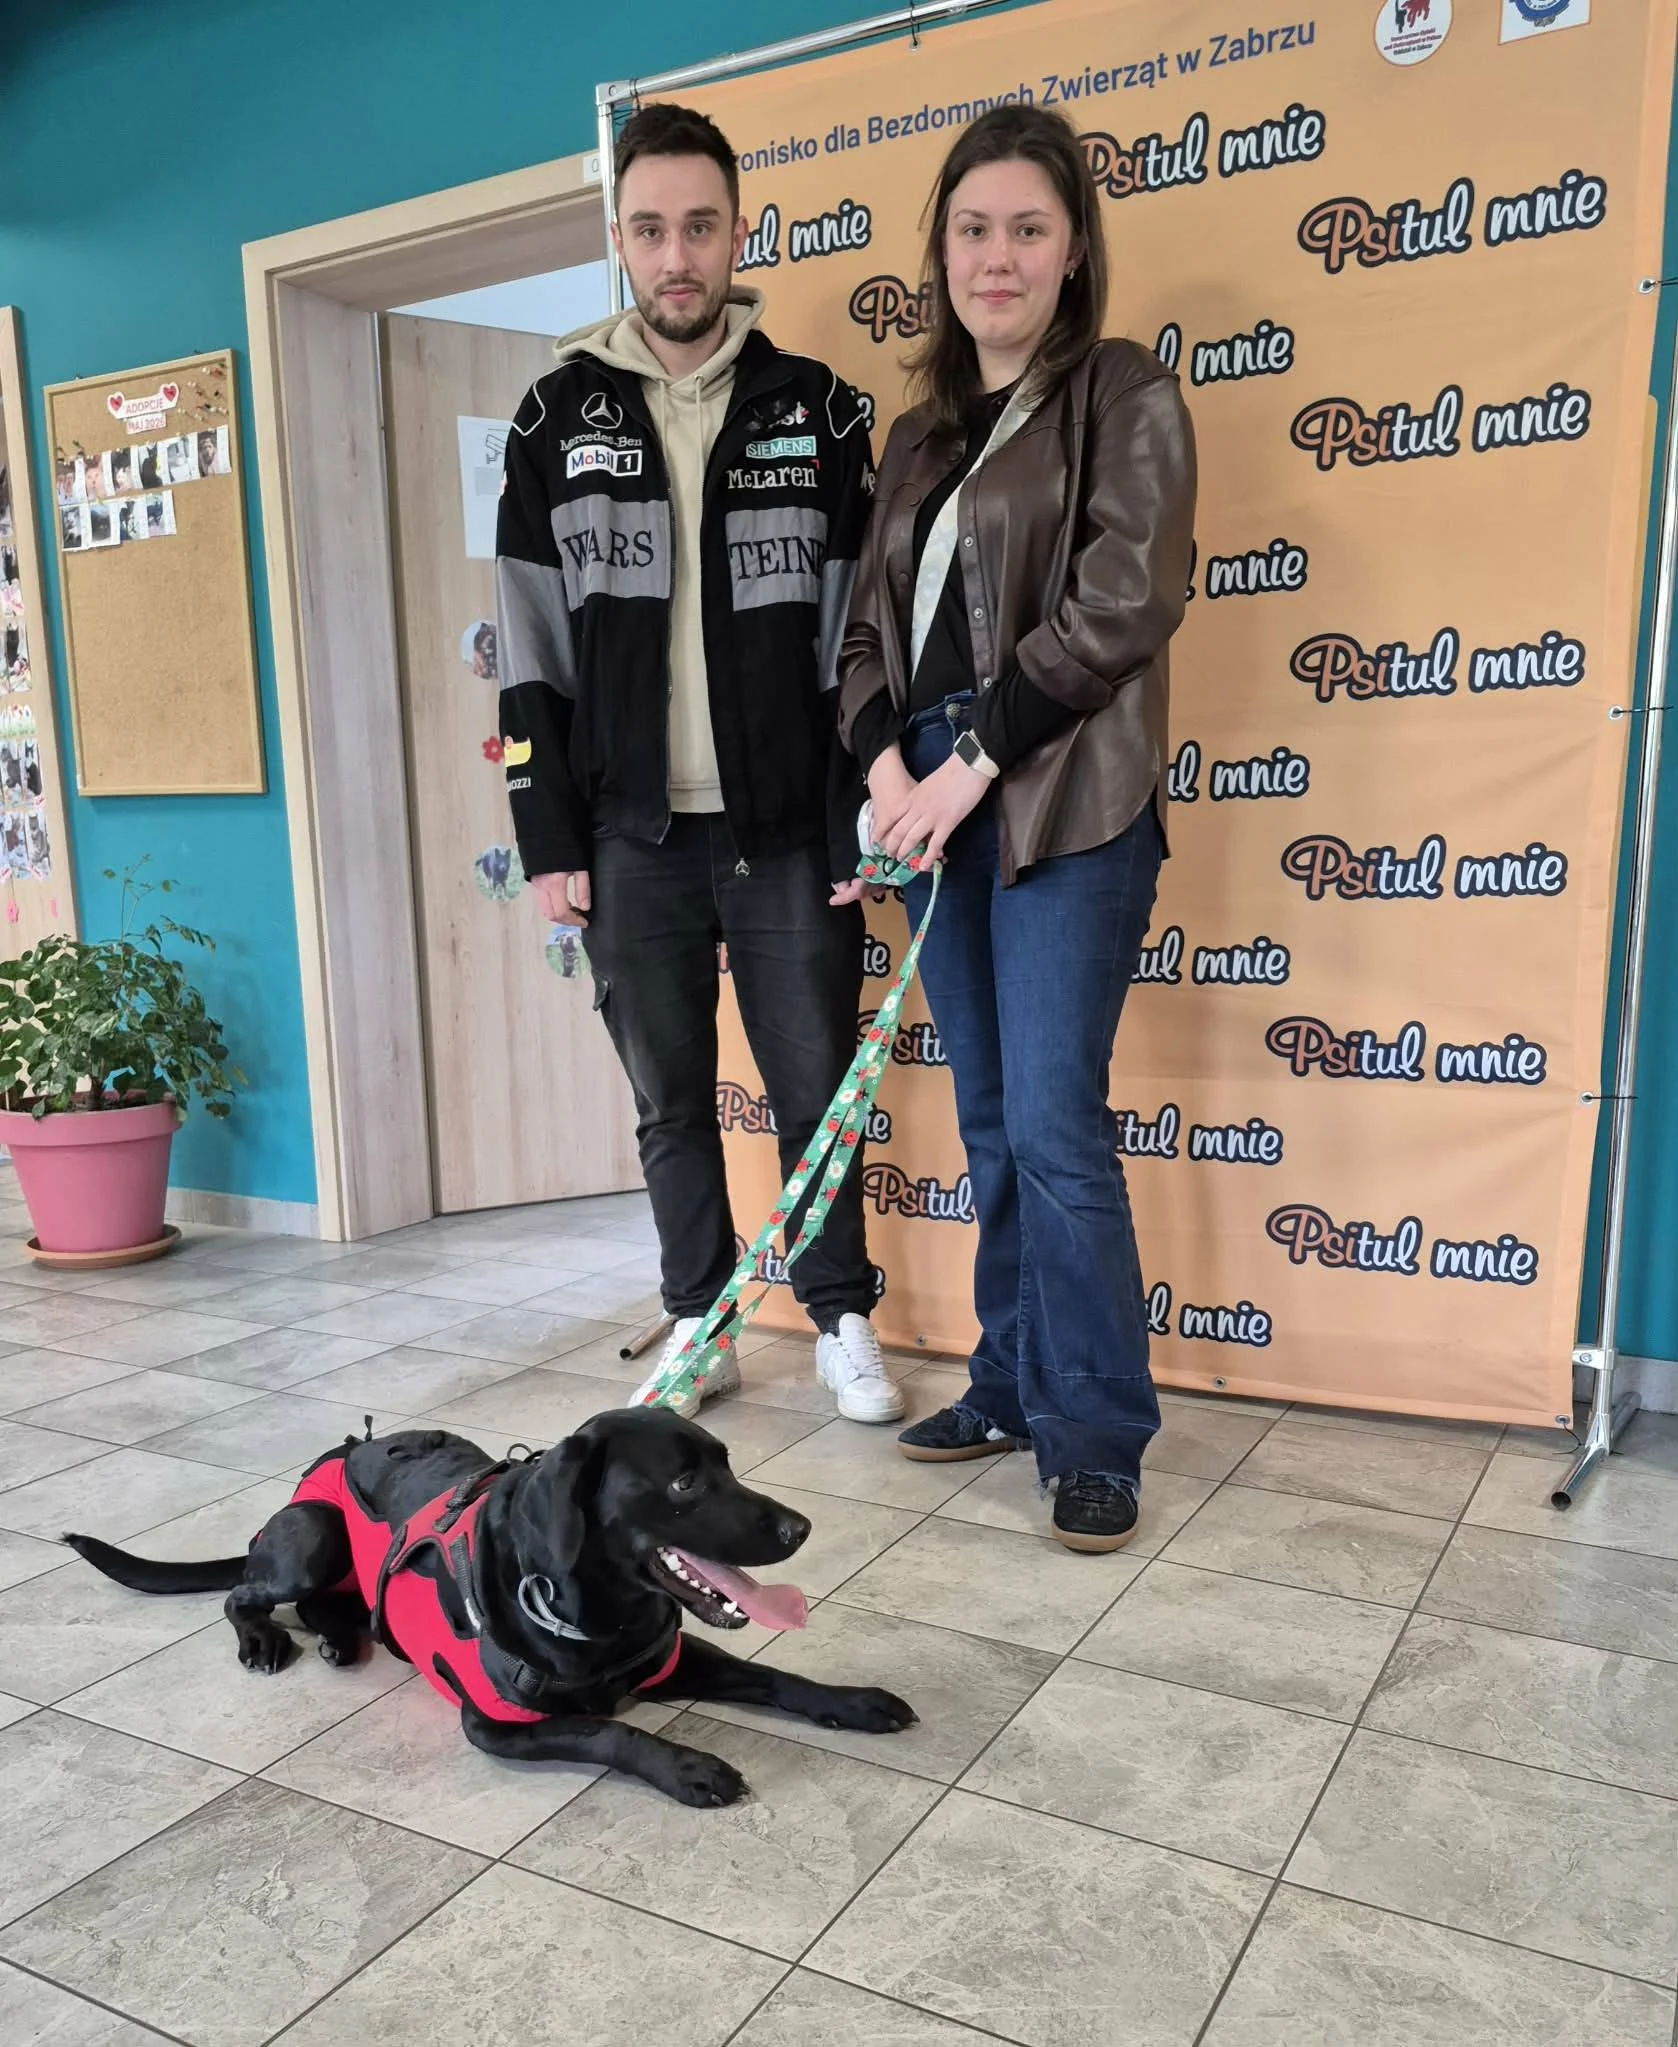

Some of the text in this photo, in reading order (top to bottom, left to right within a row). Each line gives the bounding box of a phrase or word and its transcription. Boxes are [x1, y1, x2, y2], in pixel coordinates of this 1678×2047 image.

[736, 136, 818, 174] onisko
[824, 124, 861, 154] dla
[1041, 52, 1168, 106] Zwierząt
[1176, 47, 1202, 75] w
[1208, 20, 1316, 68] Zabrzu
[1079, 107, 1322, 196] Psitul mnie
[790, 203, 869, 258] mnie
[1300, 173, 1602, 270] Psitul mnie
[1194, 324, 1292, 383] mnie
[747, 439, 812, 457] SIEMENS
[1294, 386, 1587, 467] Psitul mnie
[572, 450, 632, 471] Mobil 1
[727, 466, 818, 489] McLaren
[562, 526, 653, 571] WARS
[1207, 542, 1305, 596] mnie
[1293, 631, 1582, 699] Psitul mnie
[1212, 749, 1306, 798] mnie
[1284, 837, 1564, 897] Psitul mnie
[1195, 939, 1287, 983] mnie
[1269, 1018, 1544, 1081] Psitul mnie
[1191, 1121, 1281, 1162] mnie
[863, 1166, 972, 1220] Psitul
[1269, 1207, 1534, 1281] Psitul mnie
[1182, 1303, 1269, 1344] mnie
